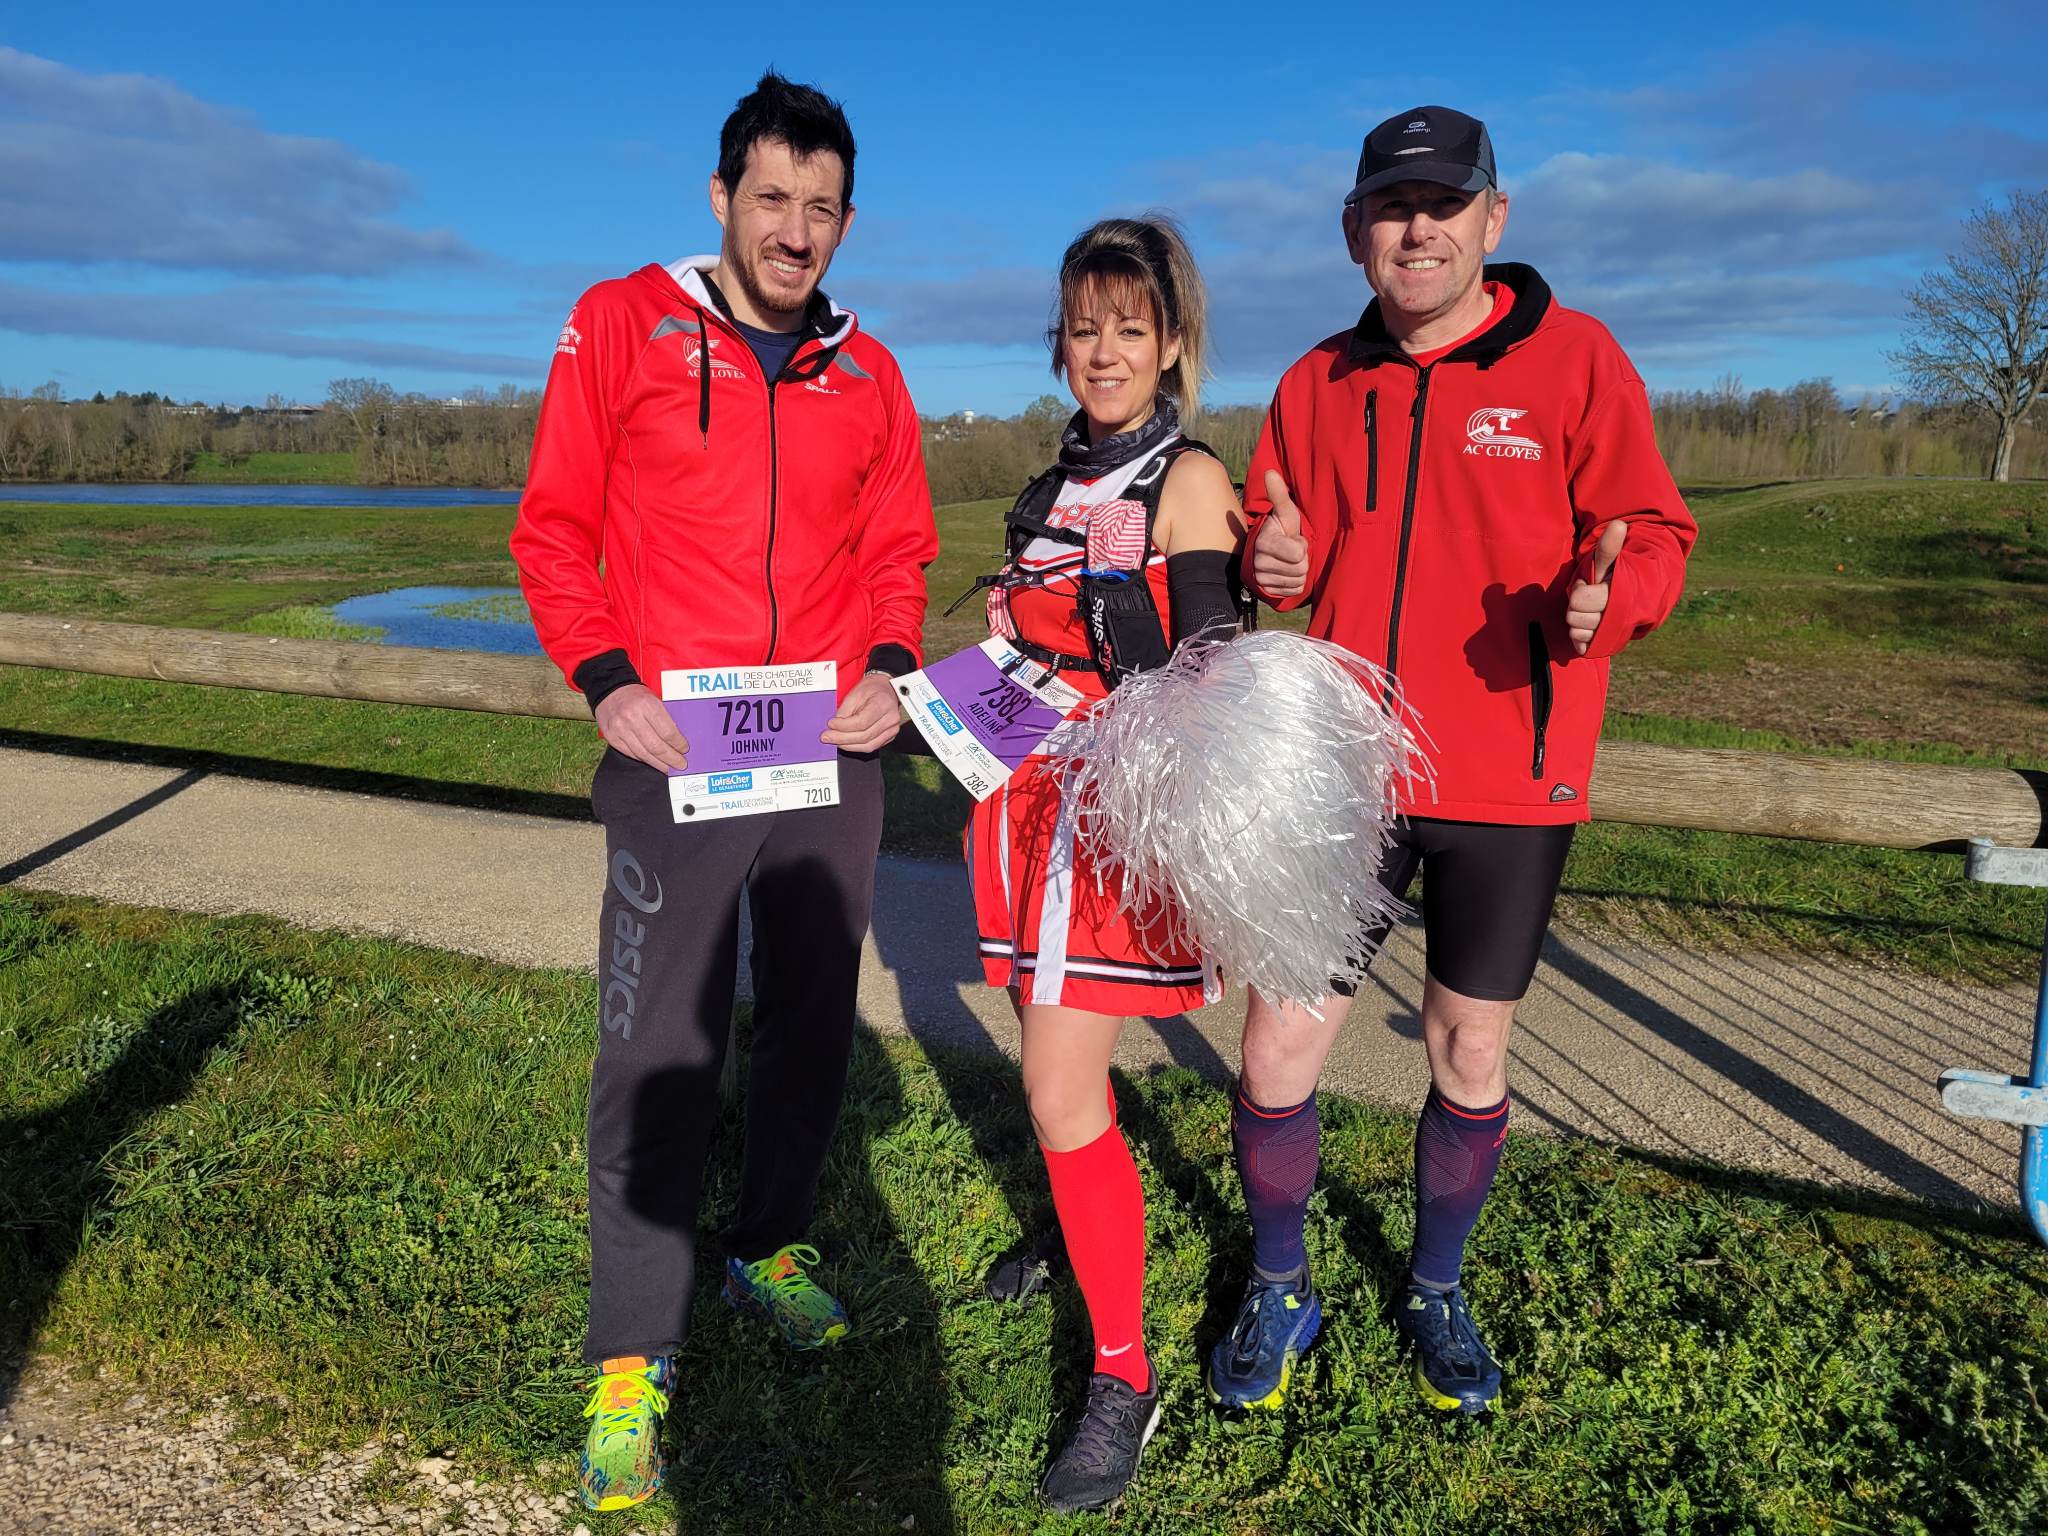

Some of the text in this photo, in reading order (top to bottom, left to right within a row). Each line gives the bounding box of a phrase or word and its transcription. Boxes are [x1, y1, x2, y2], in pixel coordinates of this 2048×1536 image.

[687, 369, 746, 379] AC LOYES
[1462, 443, 1543, 462] AC CLOYES
[687, 673, 743, 692] TRAIL
[744, 671, 763, 680] DES
[744, 676, 813, 689] DE LA LOIRE
[979, 678, 1032, 726] 7382
[718, 699, 784, 736] 7210
[731, 738, 775, 755] JOHNNY
[963, 772, 988, 795] 7382
[804, 787, 831, 804] 7210
